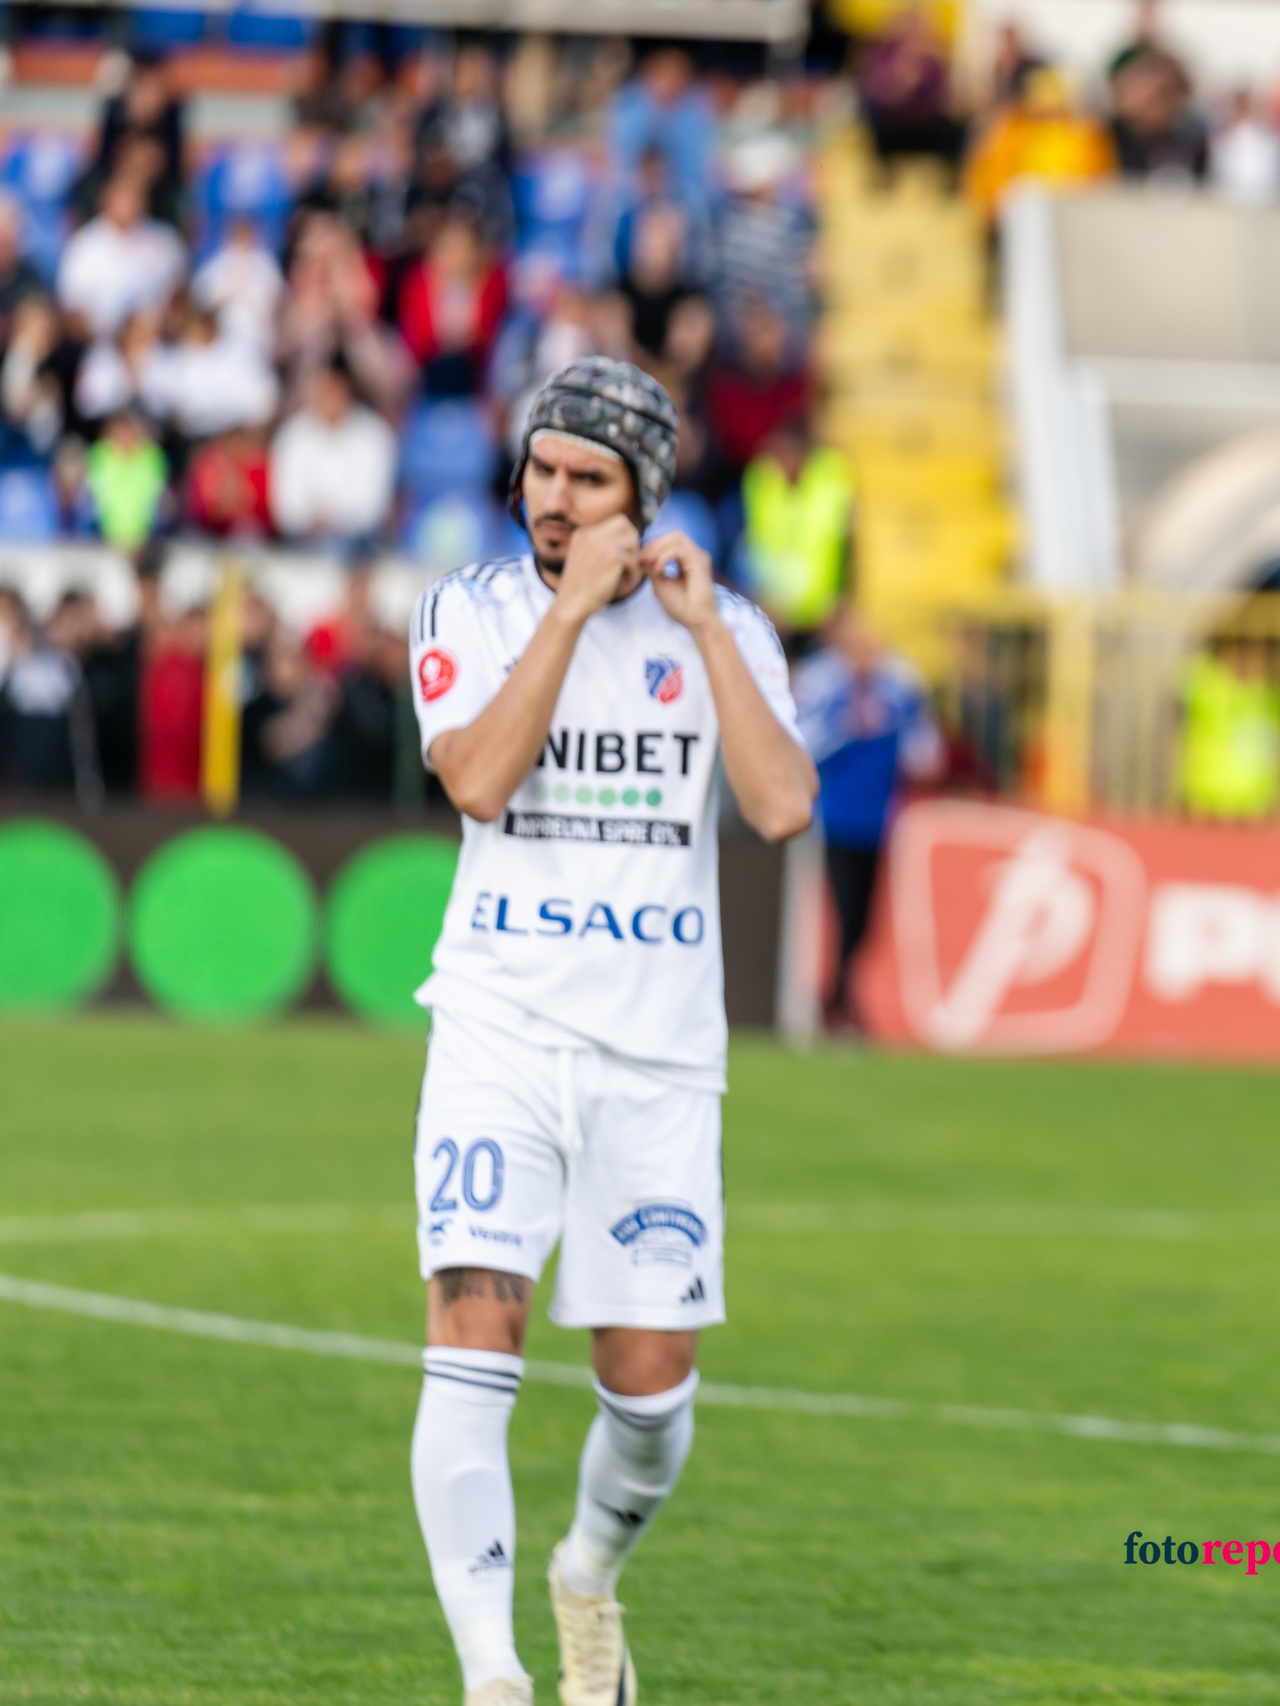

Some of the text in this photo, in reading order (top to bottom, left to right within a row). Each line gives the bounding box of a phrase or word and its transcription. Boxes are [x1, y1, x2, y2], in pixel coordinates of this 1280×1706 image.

[536, 727, 699, 776] NIBET
[471, 891, 704, 945] ELSACO
[430, 1138, 504, 1212] 20
